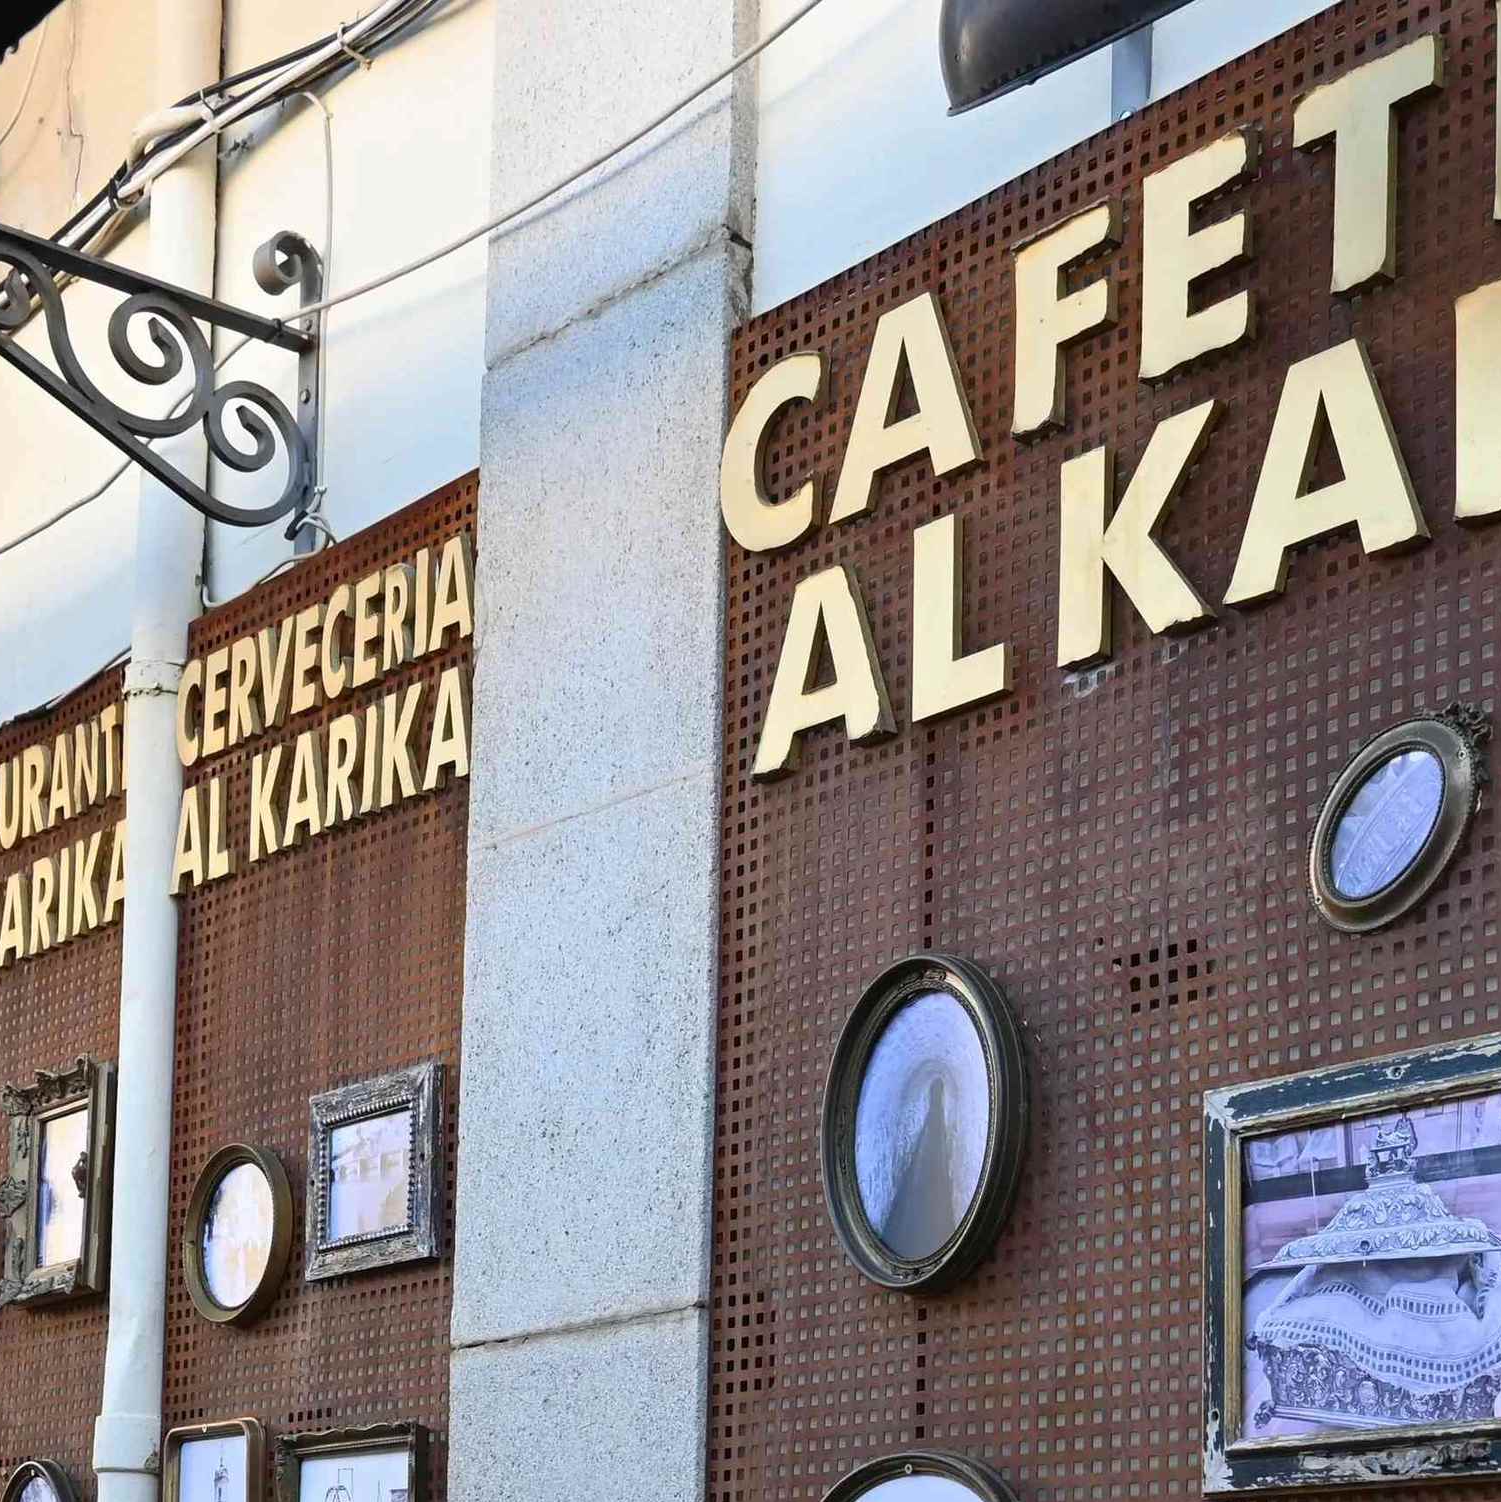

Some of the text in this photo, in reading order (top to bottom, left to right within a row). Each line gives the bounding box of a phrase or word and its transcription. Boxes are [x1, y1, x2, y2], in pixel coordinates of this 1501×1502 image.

[176, 534, 477, 768] CERVECERIA
[750, 522, 1007, 781] AL
[169, 666, 472, 897] AL KARIKA
